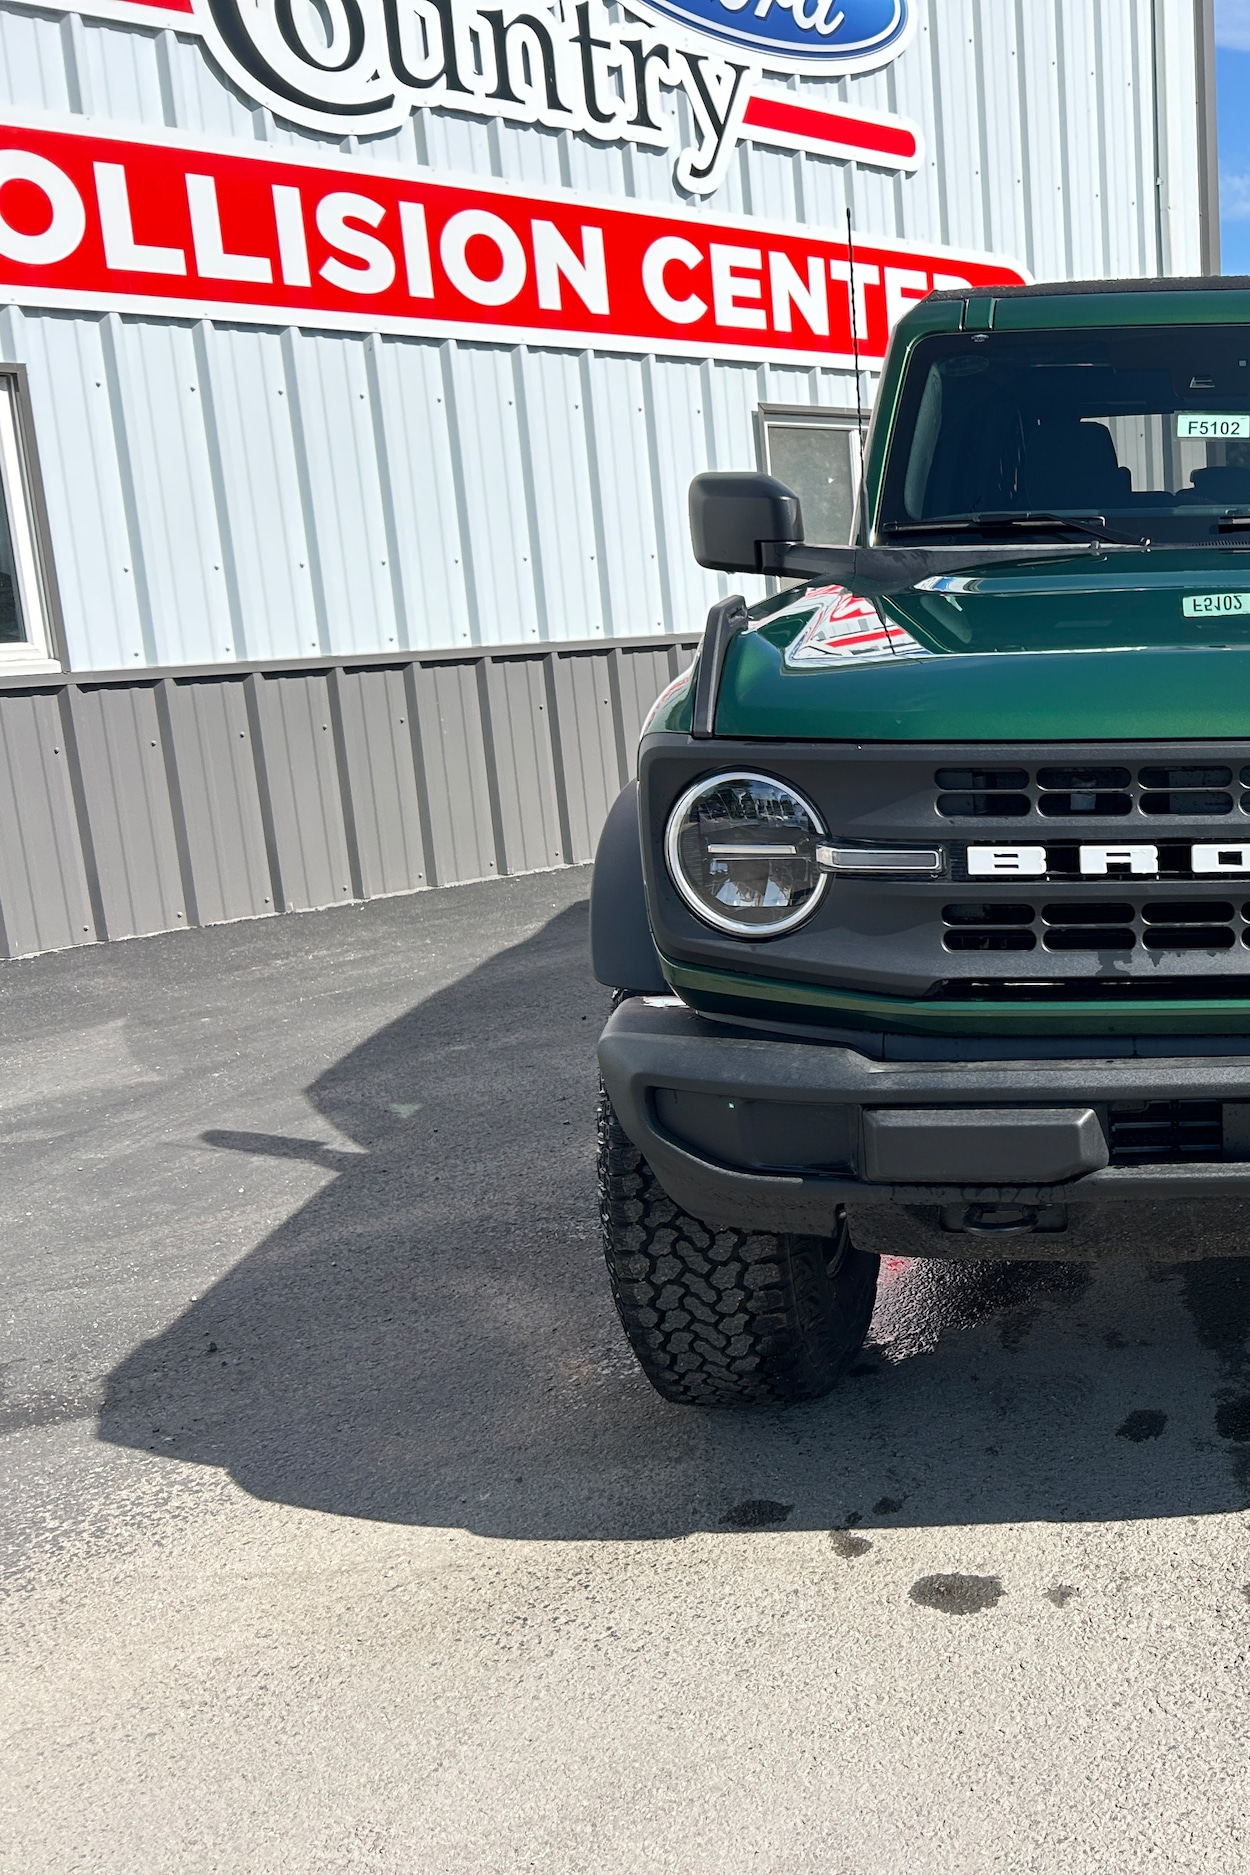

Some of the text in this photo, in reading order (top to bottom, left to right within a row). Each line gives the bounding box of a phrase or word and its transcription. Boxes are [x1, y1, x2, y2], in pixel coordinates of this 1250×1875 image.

[0, 147, 973, 340] OLLISION CENTE
[1188, 421, 1240, 435] F5102
